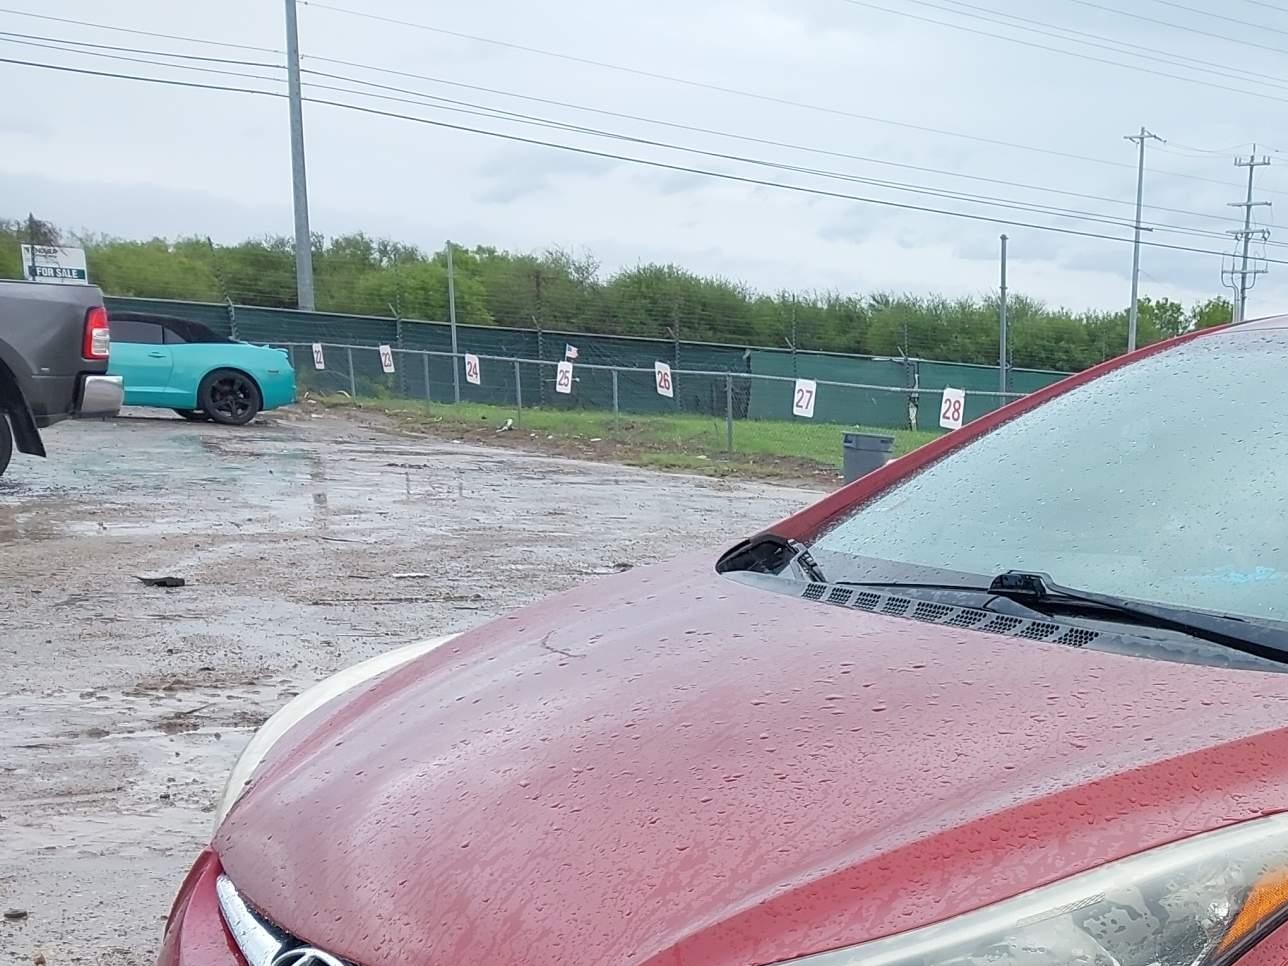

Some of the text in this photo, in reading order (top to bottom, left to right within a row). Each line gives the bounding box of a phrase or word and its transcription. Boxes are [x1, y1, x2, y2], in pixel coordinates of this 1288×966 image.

[36, 267, 78, 279] FOR SALE
[315, 350, 323, 364] 22
[382, 352, 392, 368] 23
[467, 361, 478, 379] 24
[558, 370, 570, 387] 25
[657, 370, 671, 390] 26
[795, 388, 814, 410] 27
[942, 398, 962, 422] 28
